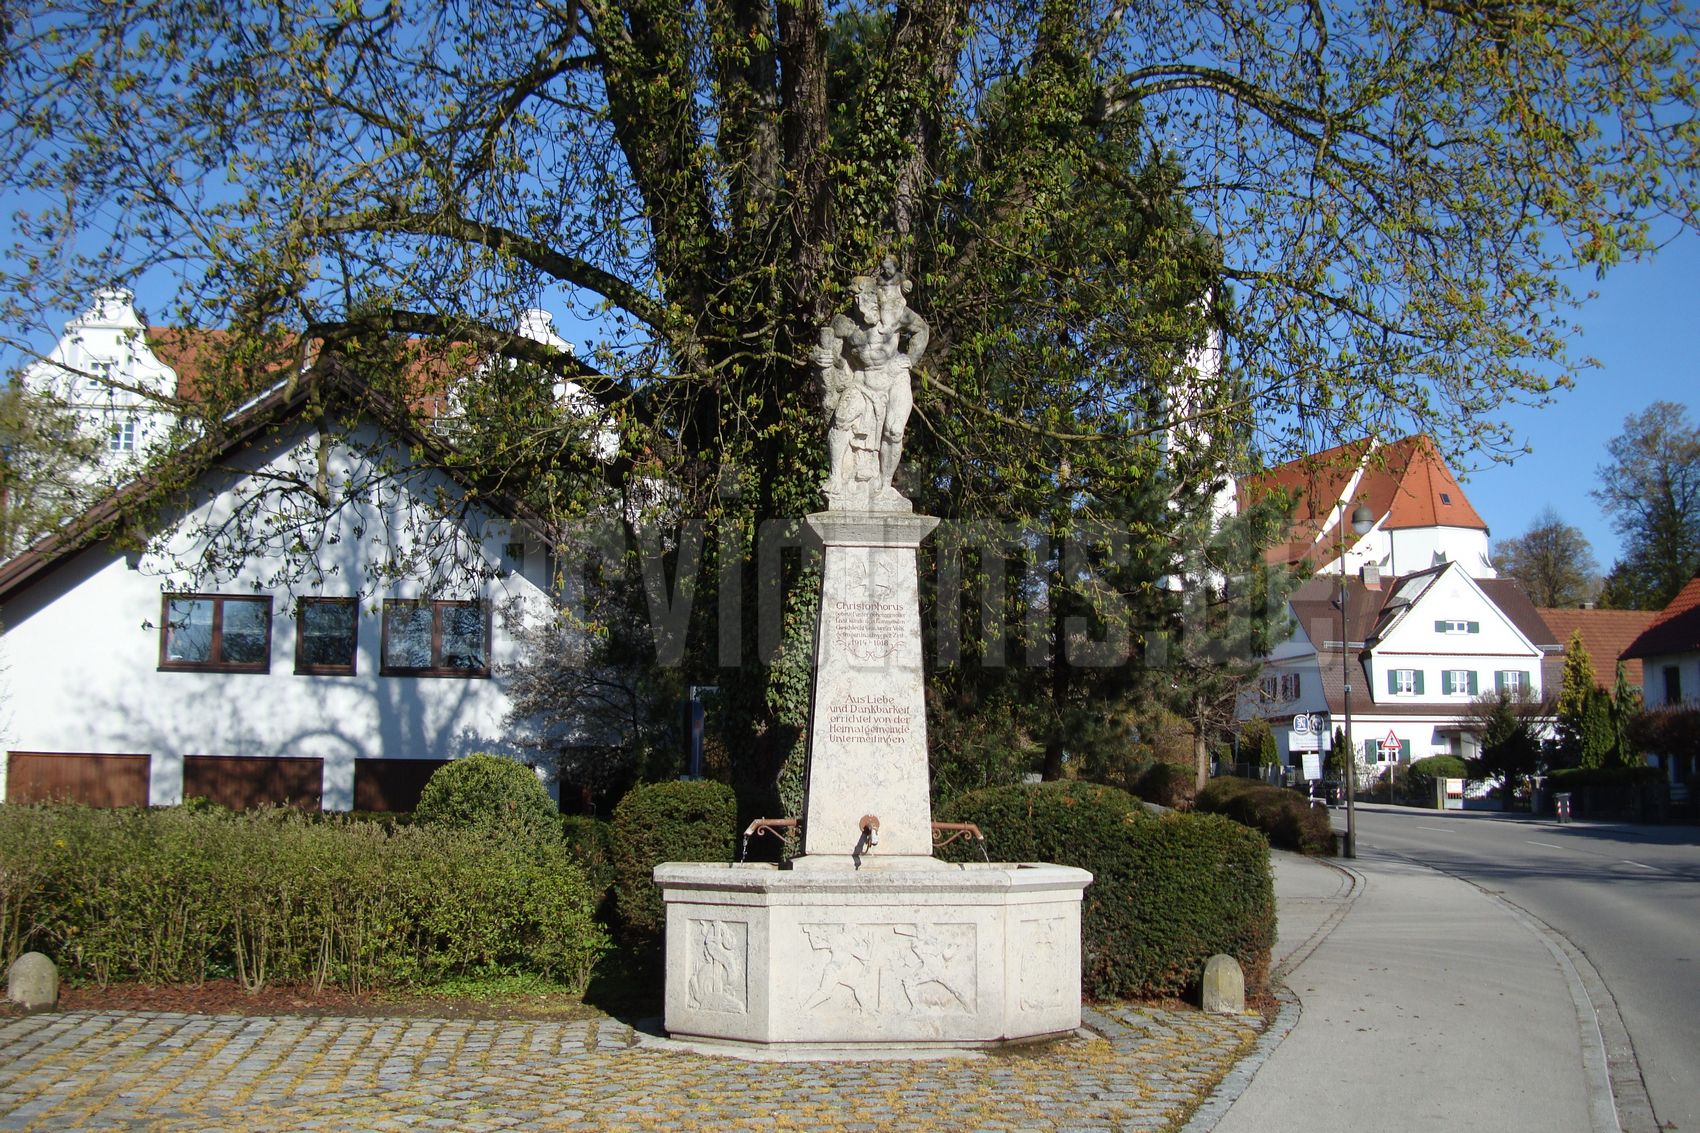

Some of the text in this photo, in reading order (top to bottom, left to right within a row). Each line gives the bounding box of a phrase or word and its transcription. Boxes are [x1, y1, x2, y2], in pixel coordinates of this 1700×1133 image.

[836, 601, 904, 611] Christophorus
[845, 694, 895, 705] Aus Liebe
[829, 704, 910, 715] und Dankbarkeit
[830, 714, 872, 724] errichtet
[893, 715, 911, 724] der
[829, 724, 910, 735] Heimatgemeinde
[829, 733, 905, 746] Untermeitingen
